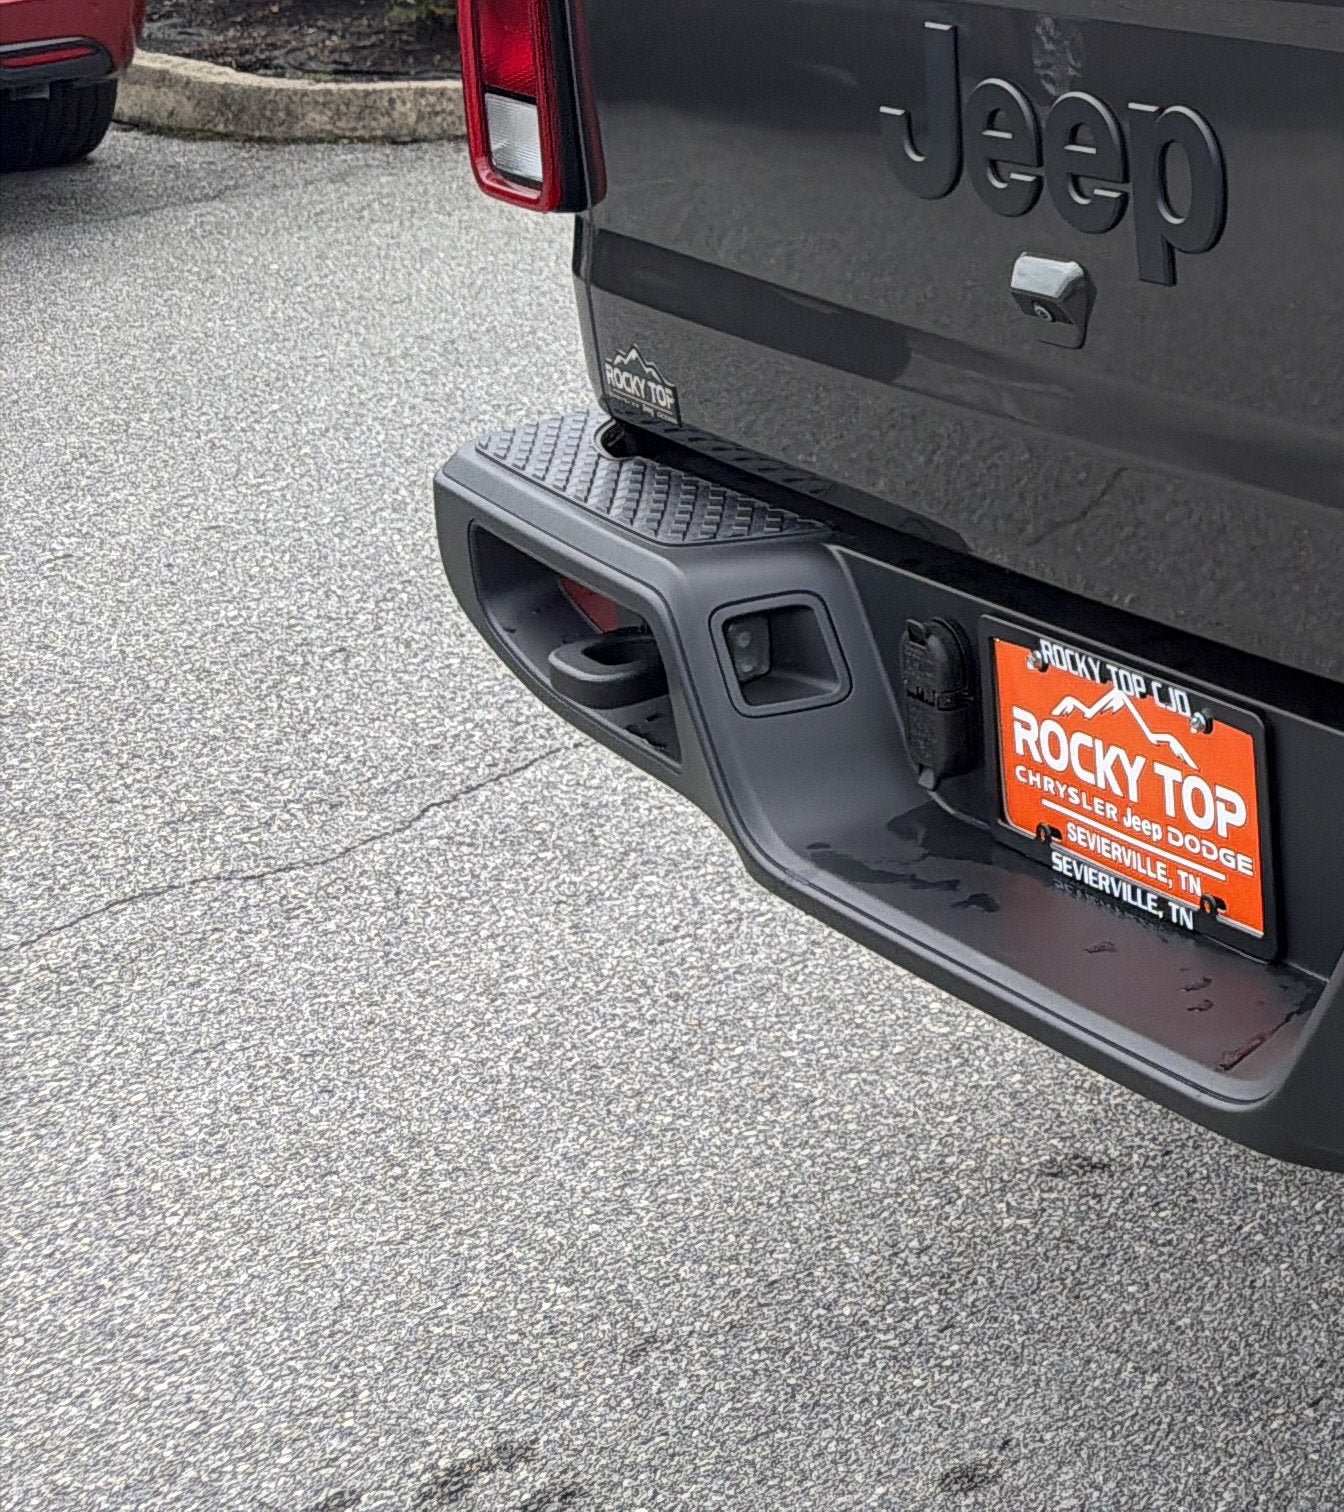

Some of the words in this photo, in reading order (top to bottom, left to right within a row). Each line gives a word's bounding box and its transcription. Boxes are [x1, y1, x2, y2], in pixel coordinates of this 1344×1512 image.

[880, 21, 1229, 286] Jeep
[605, 363, 646, 399] ROCKY
[648, 381, 676, 409] TOP
[1040, 639, 1102, 684] ROCKY
[1106, 665, 1146, 698] TOP
[1151, 682, 1192, 717] CJD
[1012, 706, 1147, 804] ROCKY
[1153, 760, 1248, 838] TOP
[1015, 765, 1119, 821] CHRYSLER
[1123, 807, 1163, 843] Jeep
[1168, 827, 1254, 876] DODGE
[1051, 852, 1164, 919] SEVIERVILLE,
[1168, 902, 1194, 930] TN
[1066, 823, 1174, 889] SEVIERVILLE,
[1177, 872, 1202, 897] TN
